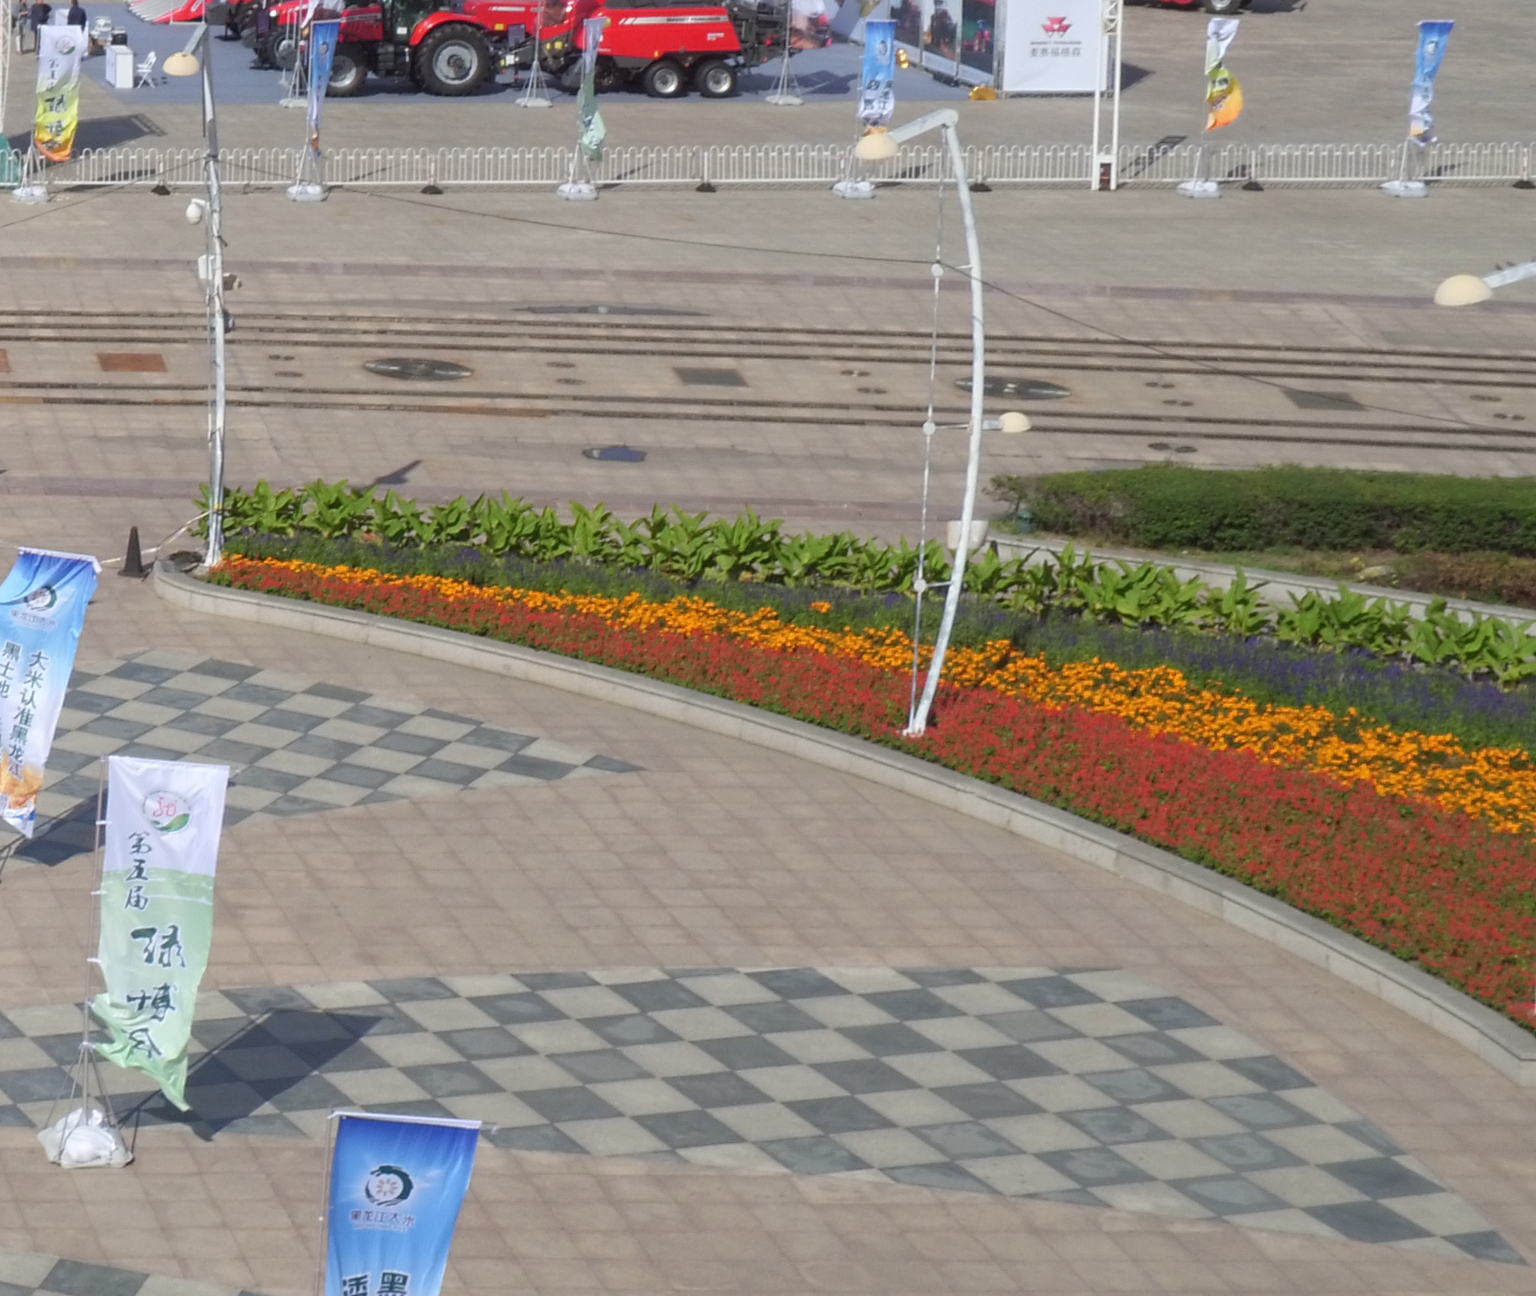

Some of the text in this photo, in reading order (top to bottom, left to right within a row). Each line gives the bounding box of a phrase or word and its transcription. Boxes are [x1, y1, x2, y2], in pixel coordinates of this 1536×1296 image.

[8, 650, 50, 781] 大米认准黑龙江
[124, 832, 153, 911] 第五届
[350, 1210, 415, 1226] 黑龙江大米
